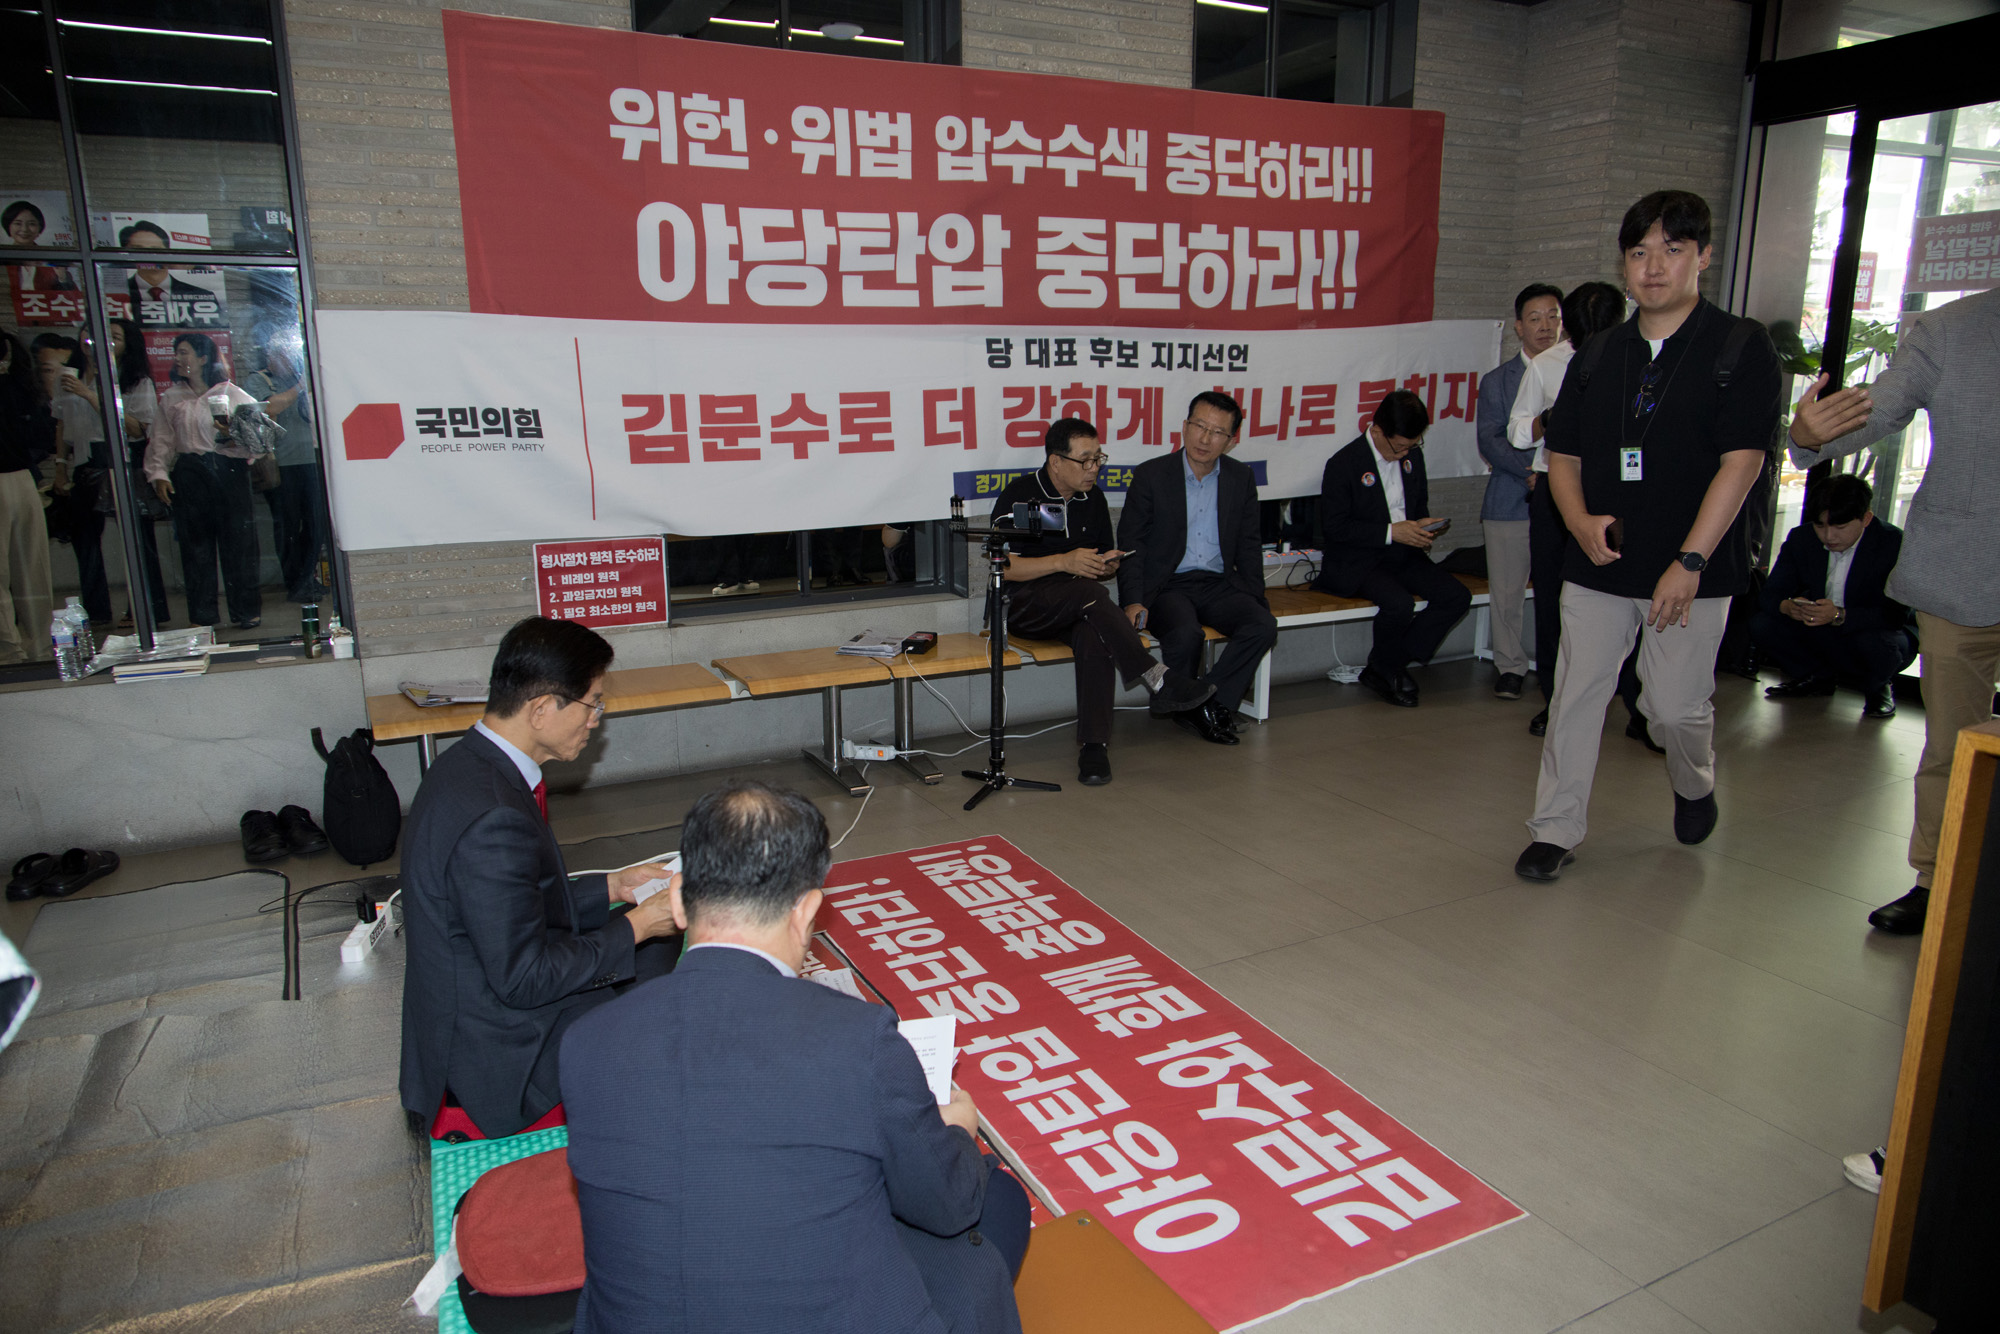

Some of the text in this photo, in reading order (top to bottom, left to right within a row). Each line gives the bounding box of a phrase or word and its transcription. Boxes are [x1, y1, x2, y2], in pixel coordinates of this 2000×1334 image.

[934, 115, 1149, 192] 압수수색
[1165, 134, 1374, 203] 중단하라!!
[636, 200, 1360, 311] 야당탄압 중단하라!!
[986, 337, 1249, 372] 당 대표 후보 지지선언
[416, 406, 544, 438] 국민의힘
[621, 391, 895, 464] 김문수로
[923, 385, 977, 451] 더
[421, 443, 545, 453] PEOPLE POWER PARTY
[541, 548, 659, 569] 형사절차 원칙 준수하라
[548, 571, 619, 586] 1. 비례의 원칙
[549, 586, 642, 603] 2. 과잉금지의 원칙
[551, 601, 656, 620] 3. 필요 최소한의 원칙
[908, 844, 1460, 1247] 김문수와 함께 총력투쟁!
[821, 877, 1240, 1253] 야당탄압 중단하라!
